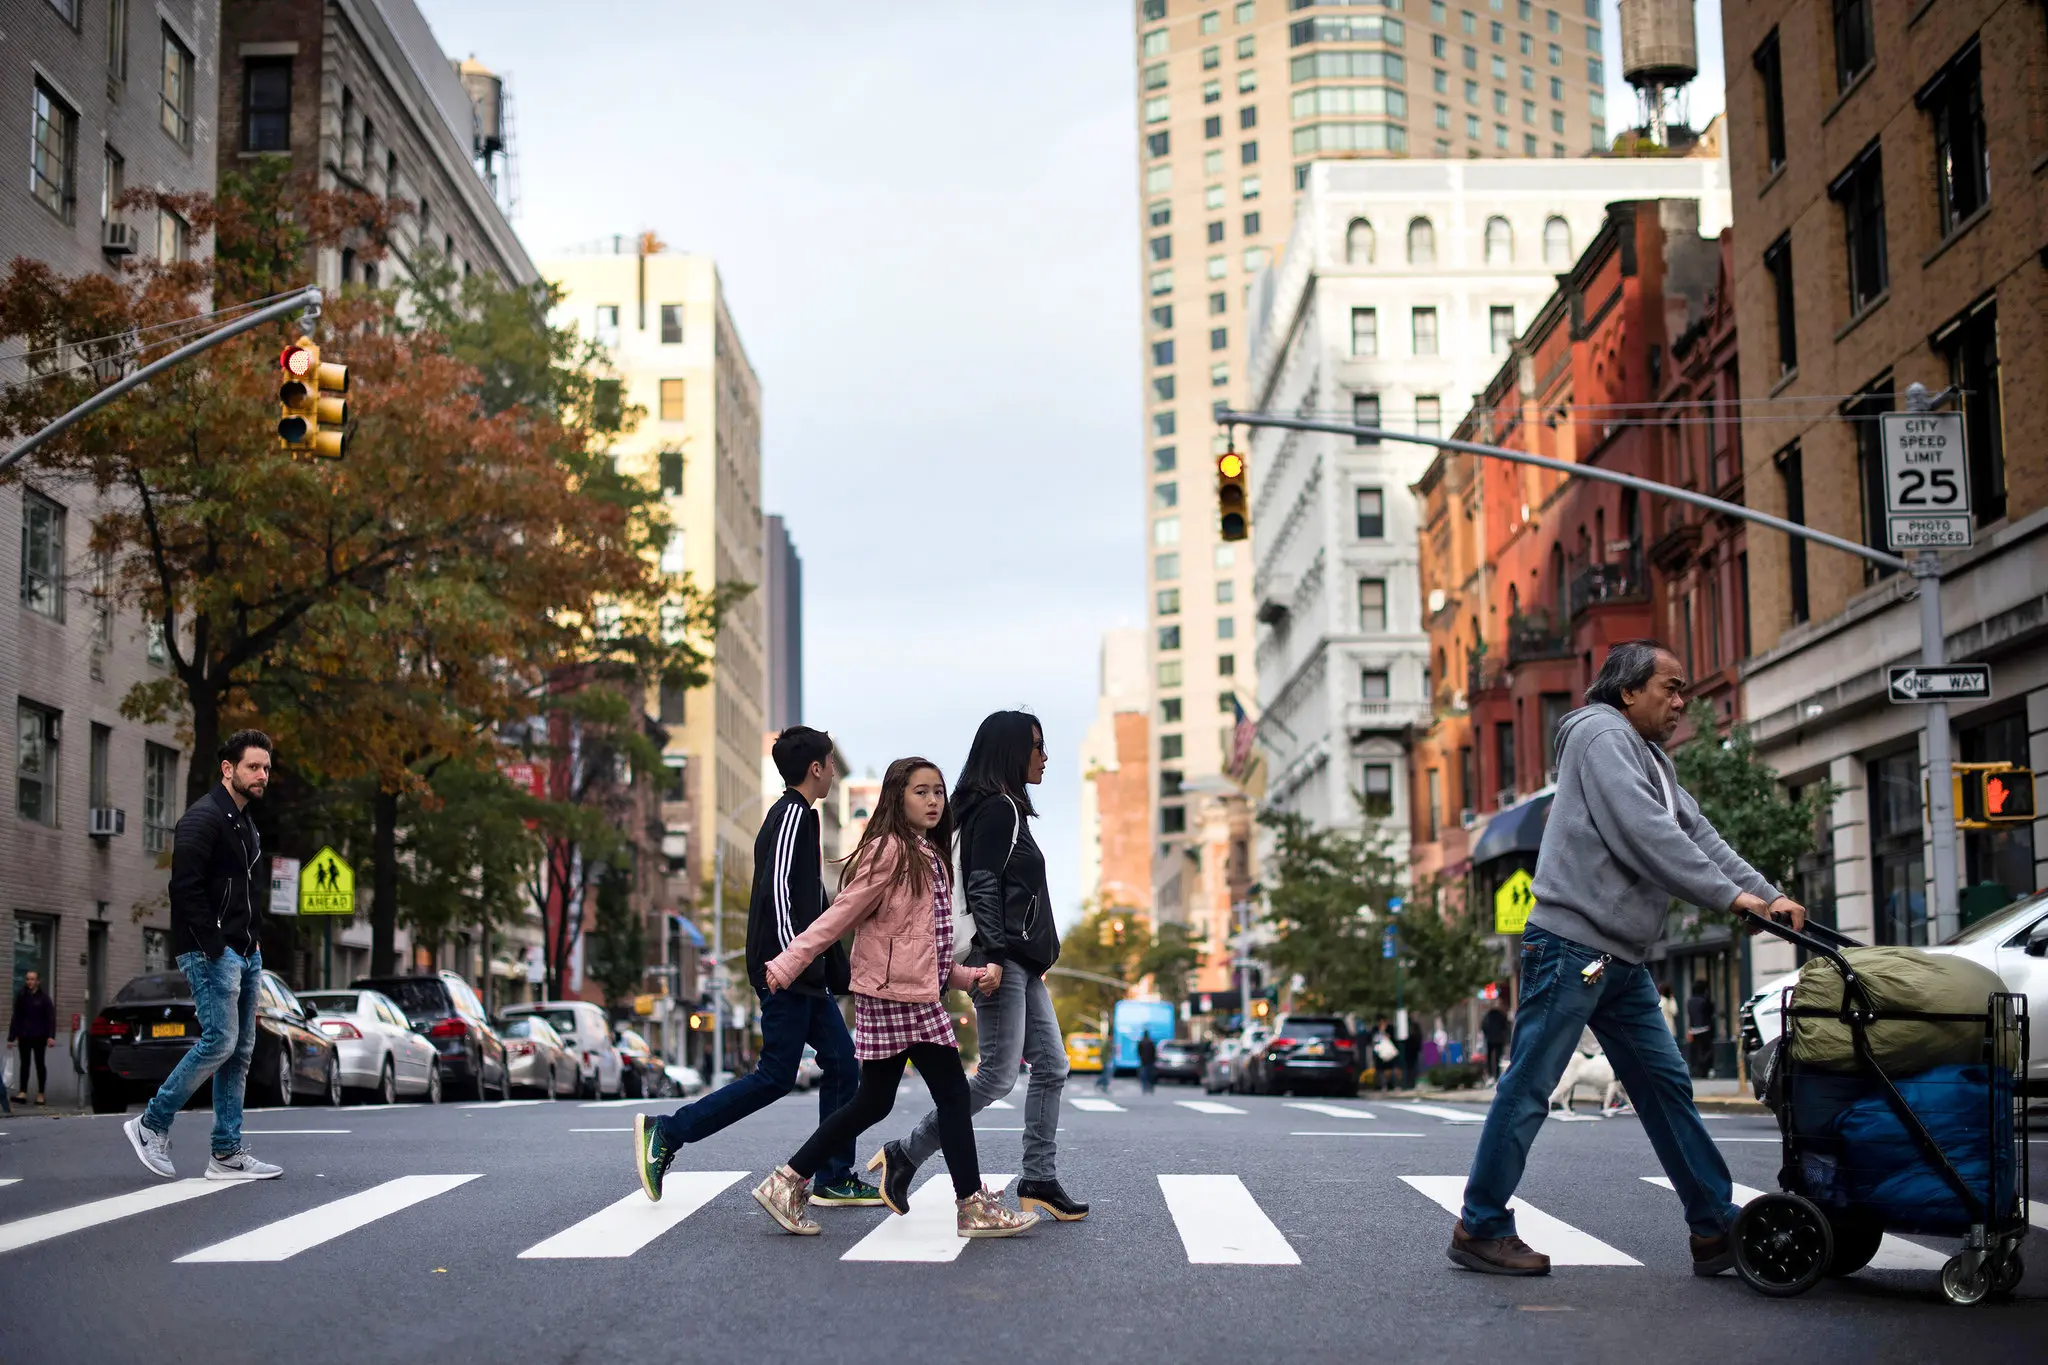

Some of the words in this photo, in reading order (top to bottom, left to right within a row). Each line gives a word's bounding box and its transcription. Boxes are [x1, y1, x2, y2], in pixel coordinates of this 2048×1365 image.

[1905, 420, 1938, 433] CITY
[1900, 435, 1947, 449] SPEED
[1905, 451, 1943, 464] LIMIT
[1898, 469, 1958, 505] 25
[1909, 521, 1951, 531] PHOTO
[1897, 531, 1965, 543] ENFORCED
[1903, 676, 1933, 692] ONE
[1949, 673, 1981, 689] WAY
[307, 896, 348, 909] AHEAD
